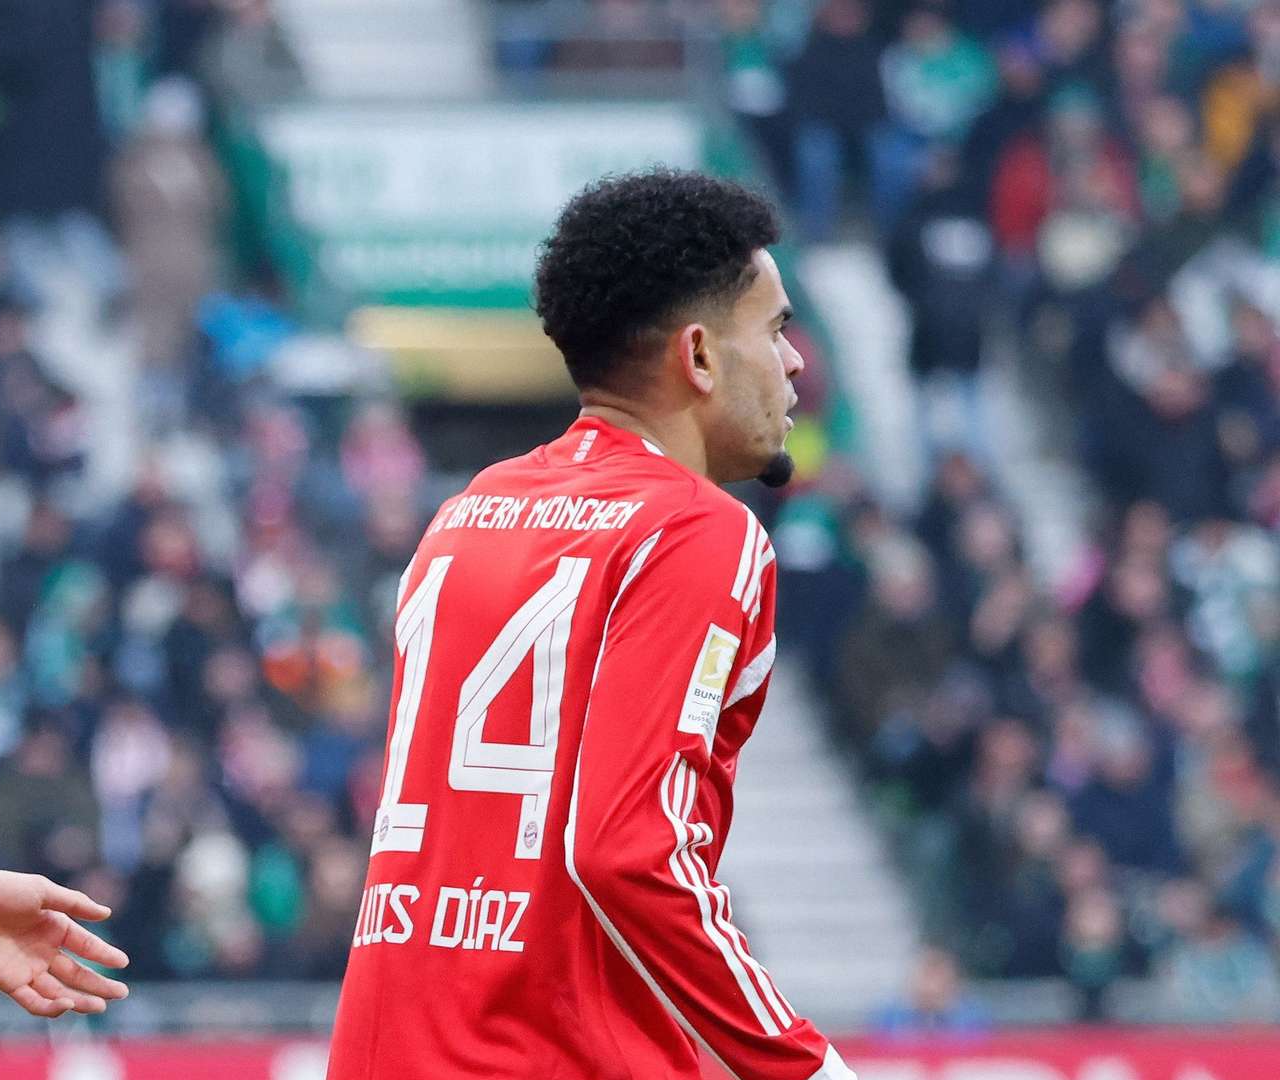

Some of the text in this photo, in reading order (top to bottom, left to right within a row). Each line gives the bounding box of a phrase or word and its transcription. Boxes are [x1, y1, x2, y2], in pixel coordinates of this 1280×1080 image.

[444, 494, 530, 530] BAYERN
[523, 495, 645, 532] MÜNCHEN
[369, 555, 591, 859] 14
[352, 876, 531, 952] LUIS DÍAZ
